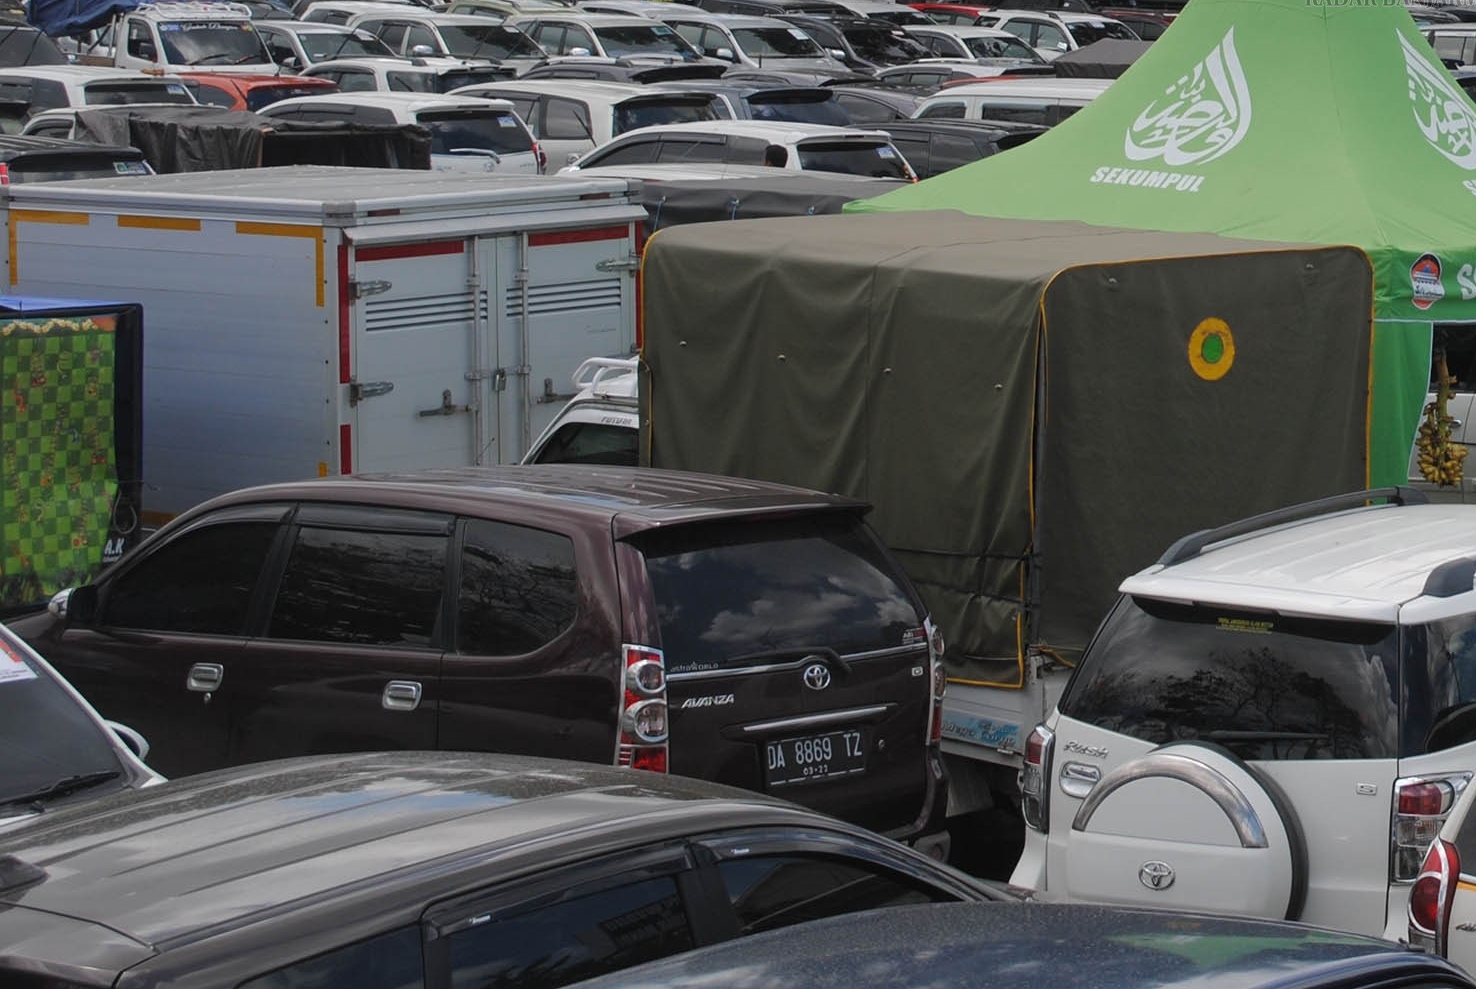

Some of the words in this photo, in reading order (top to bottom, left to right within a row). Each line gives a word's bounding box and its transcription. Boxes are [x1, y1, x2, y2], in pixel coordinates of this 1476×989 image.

[1090, 166, 1205, 192] SEKUMPUL
[681, 694, 735, 709] AVANZA
[767, 746, 786, 770] DA
[795, 737, 832, 765] 8869
[843, 732, 862, 757] TZ
